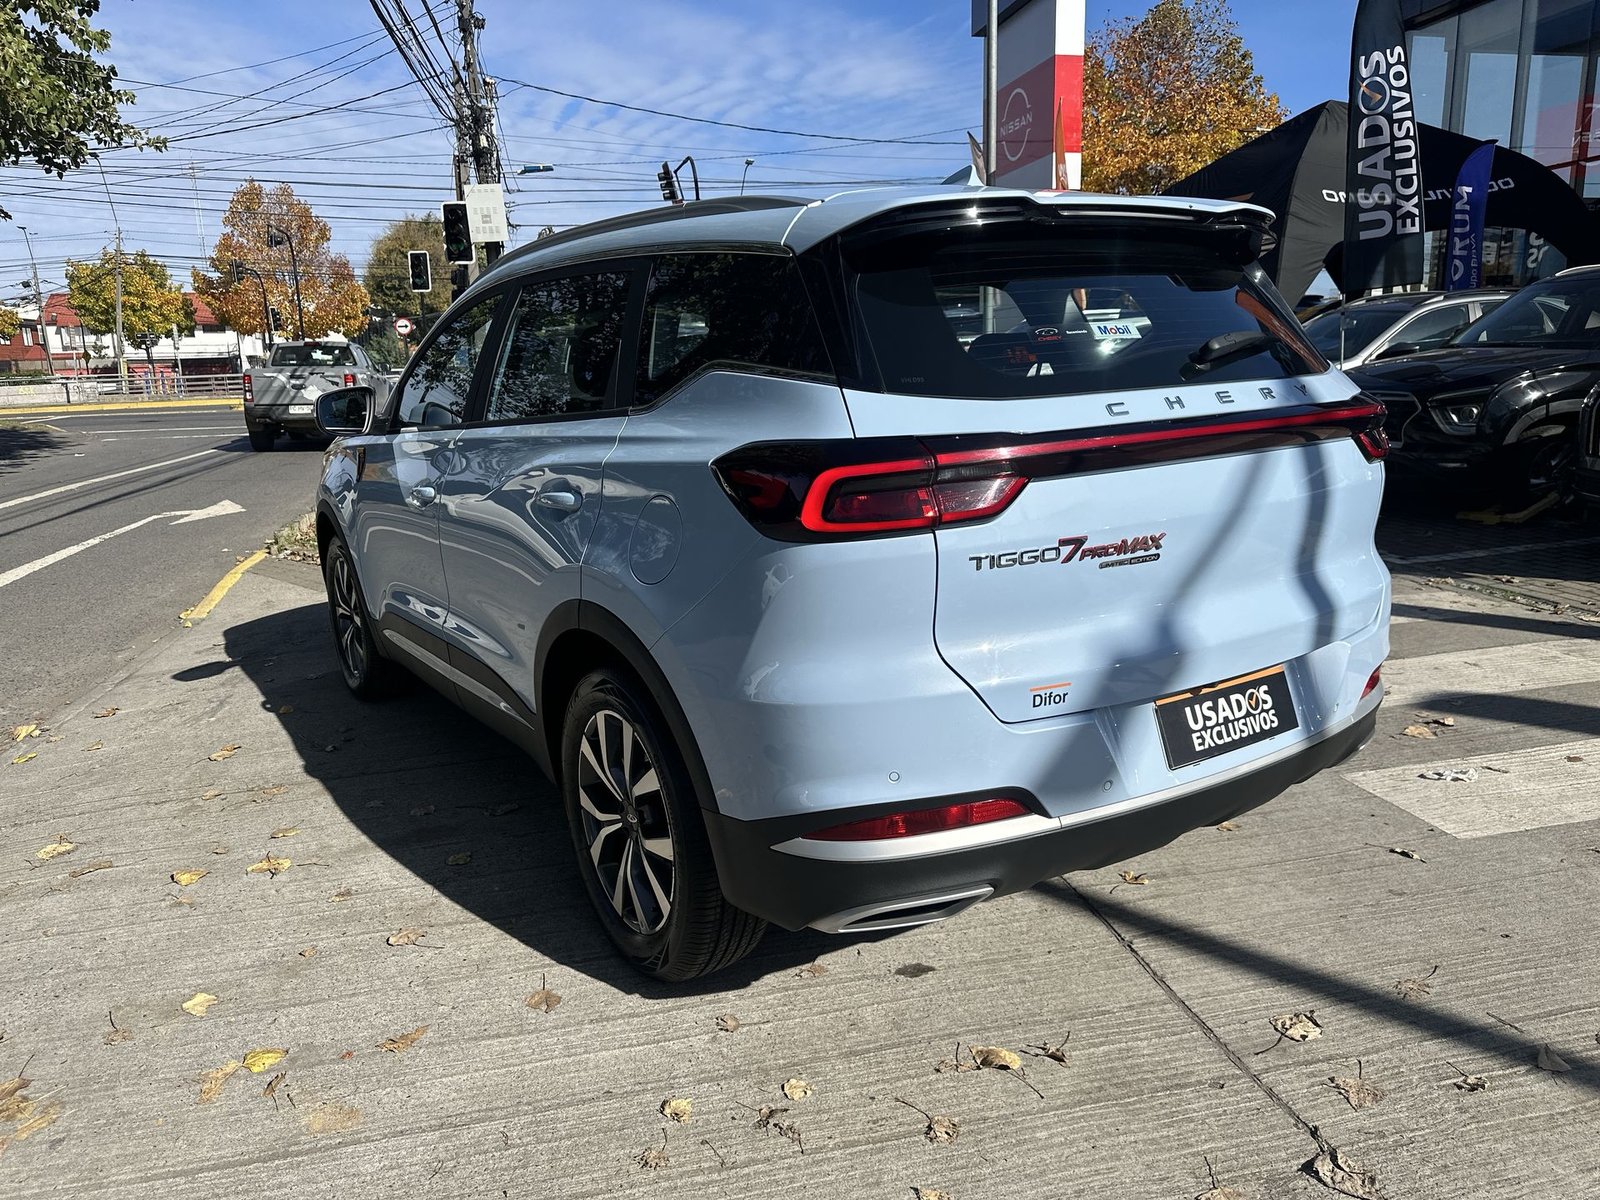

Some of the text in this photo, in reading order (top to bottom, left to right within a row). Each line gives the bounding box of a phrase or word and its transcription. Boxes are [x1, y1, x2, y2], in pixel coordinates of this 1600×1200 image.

[1000, 111, 1033, 137] NISSAN
[1386, 45, 1420, 236] EXCLUSIVOS
[1357, 50, 1393, 241] USADOS
[1450, 185, 1474, 291] ORUM
[1097, 324, 1132, 336] Mobil
[1105, 383, 1310, 417] CHERY
[969, 546, 1060, 571] TIGGO
[1058, 535, 1088, 564] 7
[1131, 554, 1158, 564] EDITION
[1032, 690, 1069, 708] Difor
[1184, 684, 1273, 732] USADOS
[1191, 709, 1279, 752] EXCLUSIVOS
